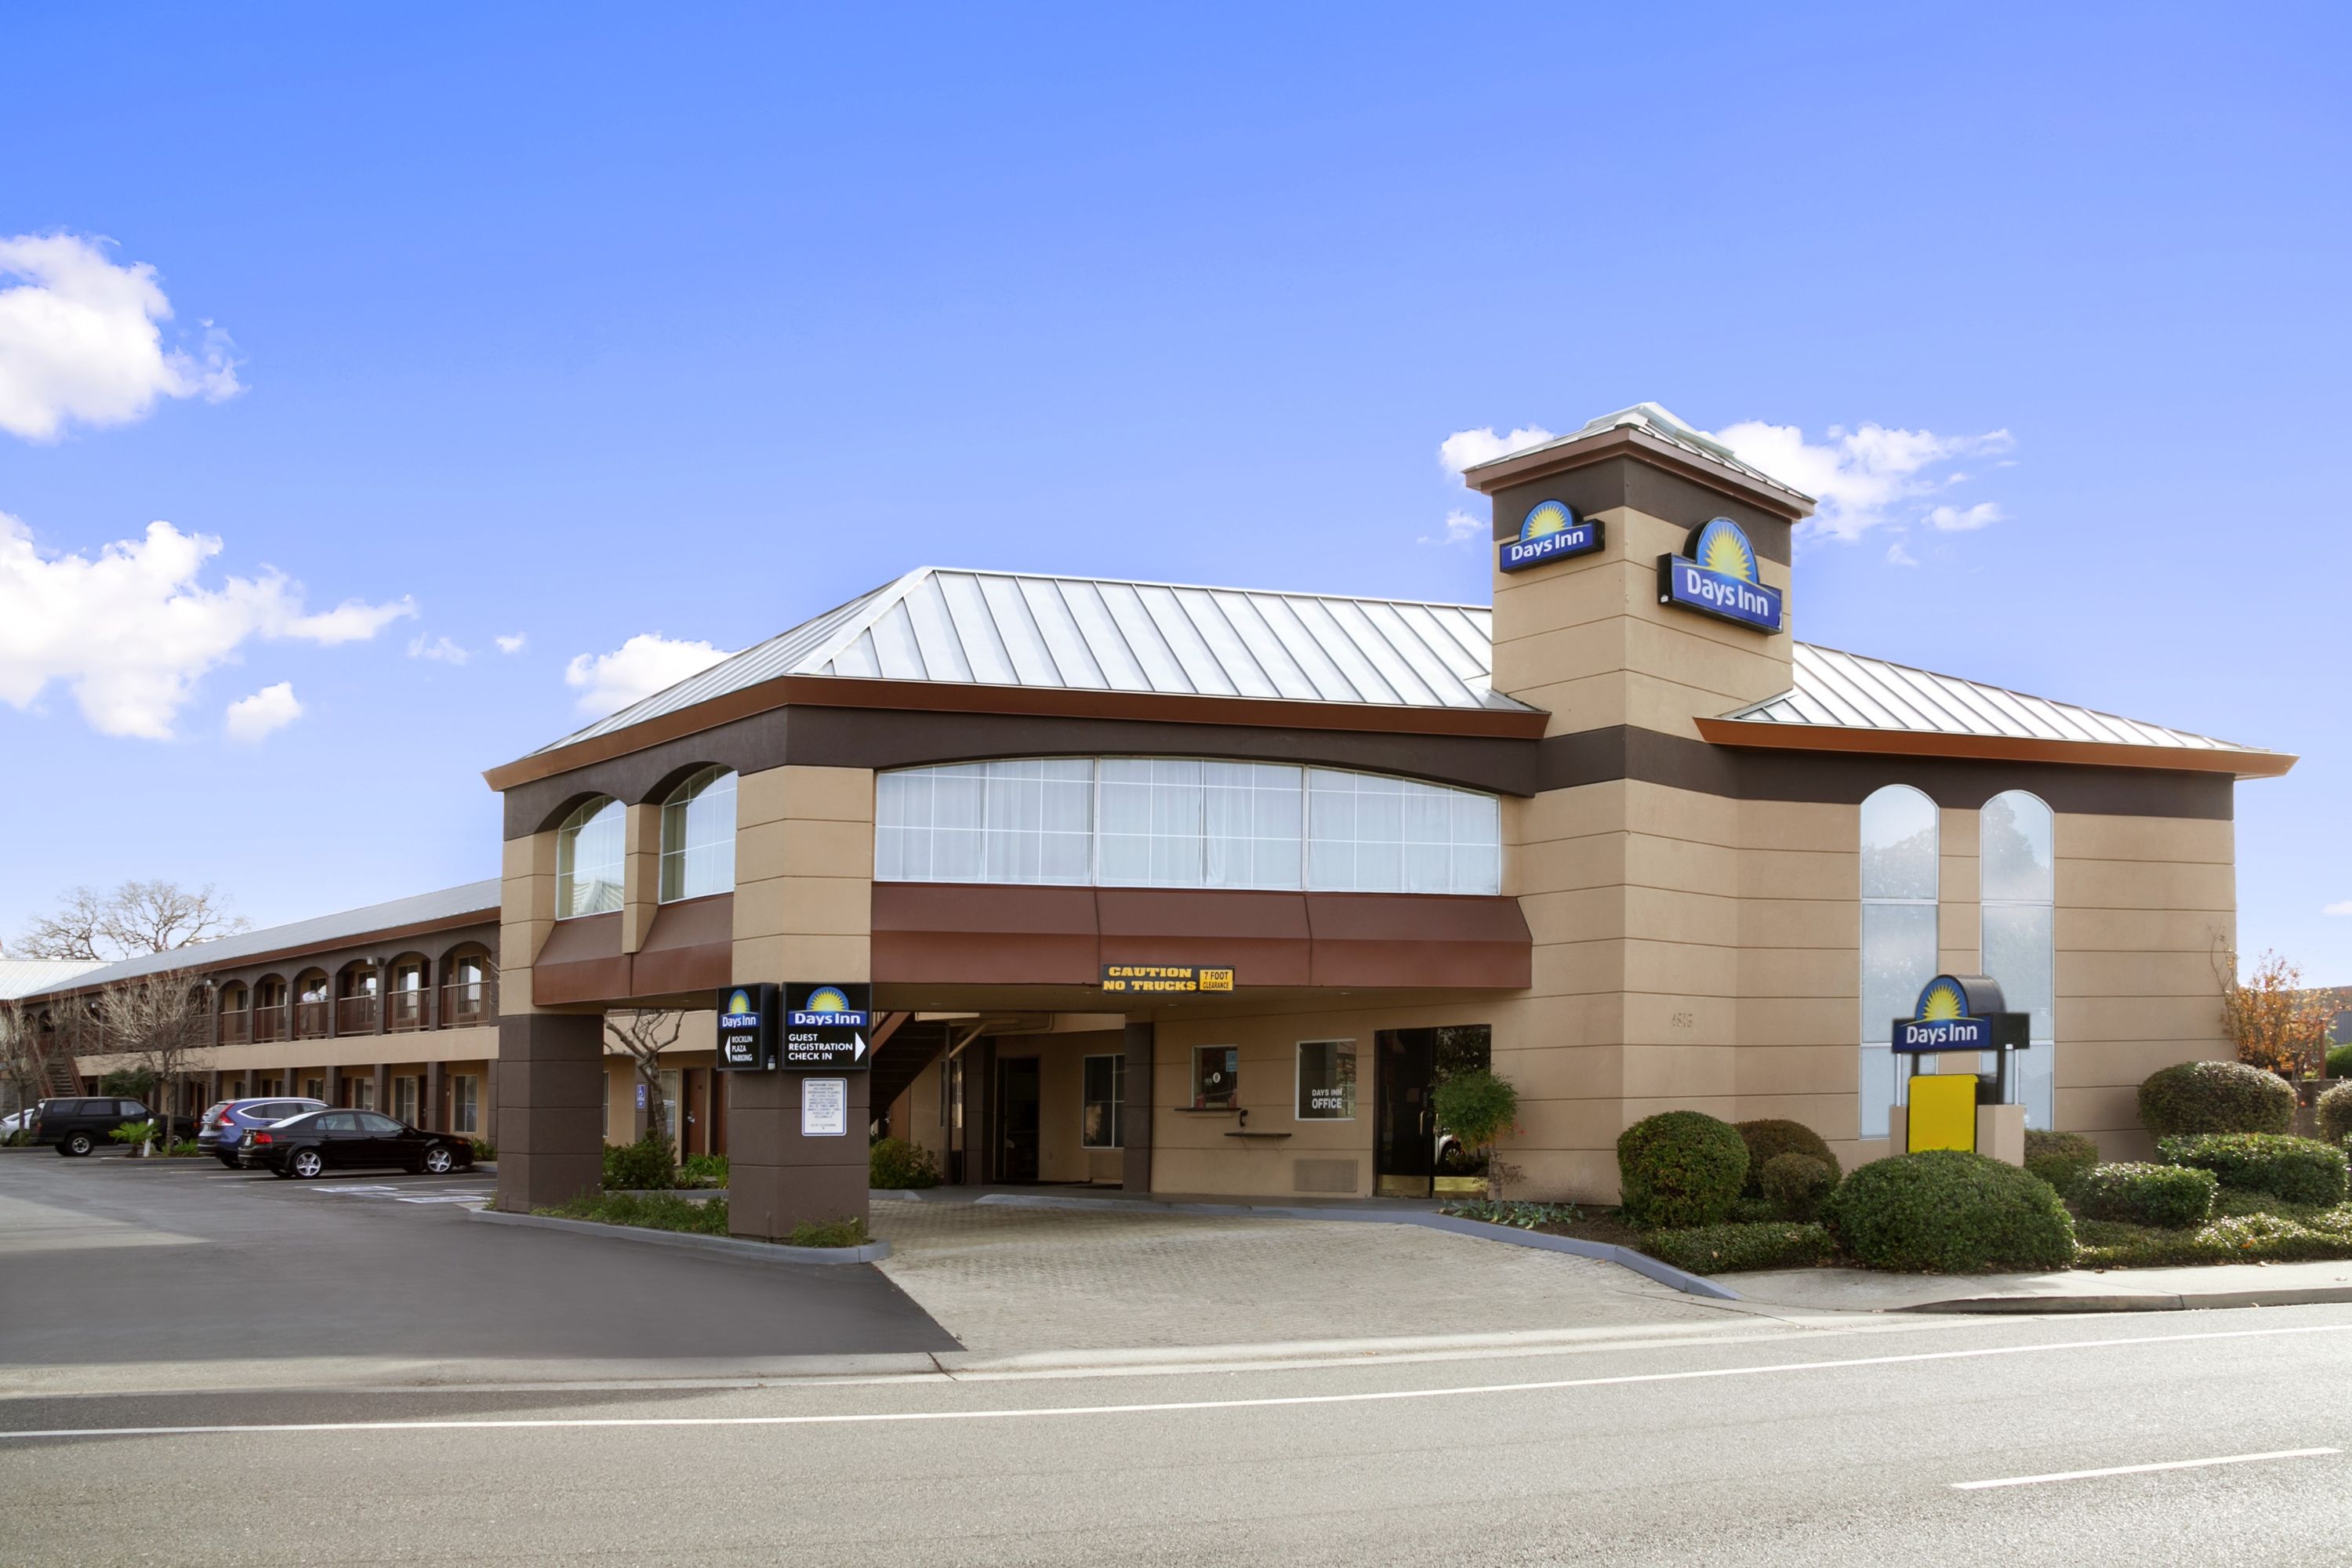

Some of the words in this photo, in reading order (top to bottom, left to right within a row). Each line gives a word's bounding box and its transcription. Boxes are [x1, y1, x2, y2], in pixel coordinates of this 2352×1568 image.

[1511, 542, 1552, 561] Days
[1555, 530, 1584, 550] Inn
[1687, 568, 1735, 606] Days
[1738, 585, 1768, 616] Inn
[1109, 967, 1192, 978] CAUTION
[1204, 971, 1208, 980] 7
[1210, 971, 1229, 980] FOOT
[1103, 981, 1126, 990] NO
[1131, 981, 1196, 991] TRUCKS
[722, 1016, 742, 1028] Days
[742, 1015, 756, 1025] Inn
[794, 1013, 832, 1025] Days
[835, 1013, 860, 1024] Inn
[1907, 1026, 1946, 1045] Days
[1949, 1023, 1977, 1041] Inn
[1312, 1098, 1342, 1109] OFFICE
